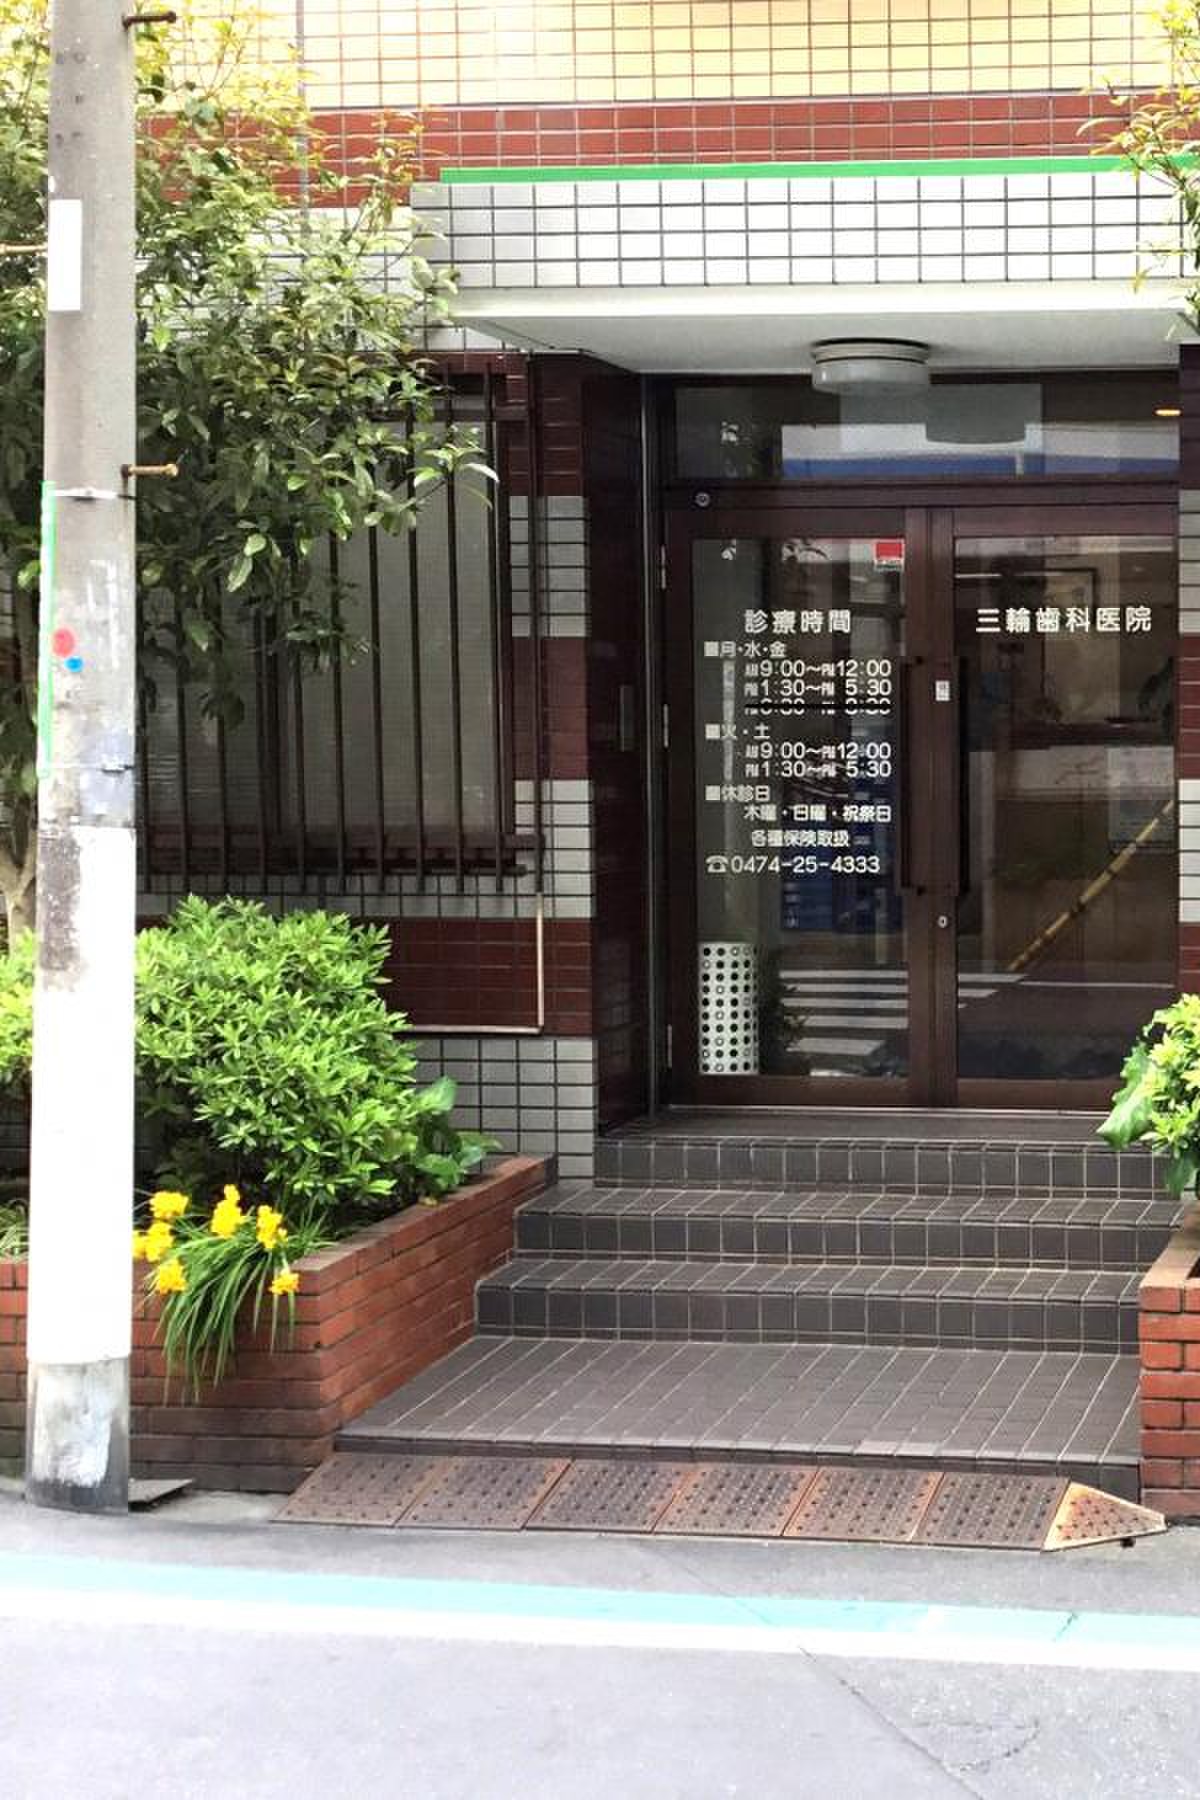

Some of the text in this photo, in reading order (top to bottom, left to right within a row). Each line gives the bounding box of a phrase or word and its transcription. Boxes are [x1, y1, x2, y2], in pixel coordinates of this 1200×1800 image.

[744, 609, 851, 634] 診療時間
[975, 605, 1152, 633] 三輪歯科医院
[731, 855, 881, 873] 0474-25-4333
